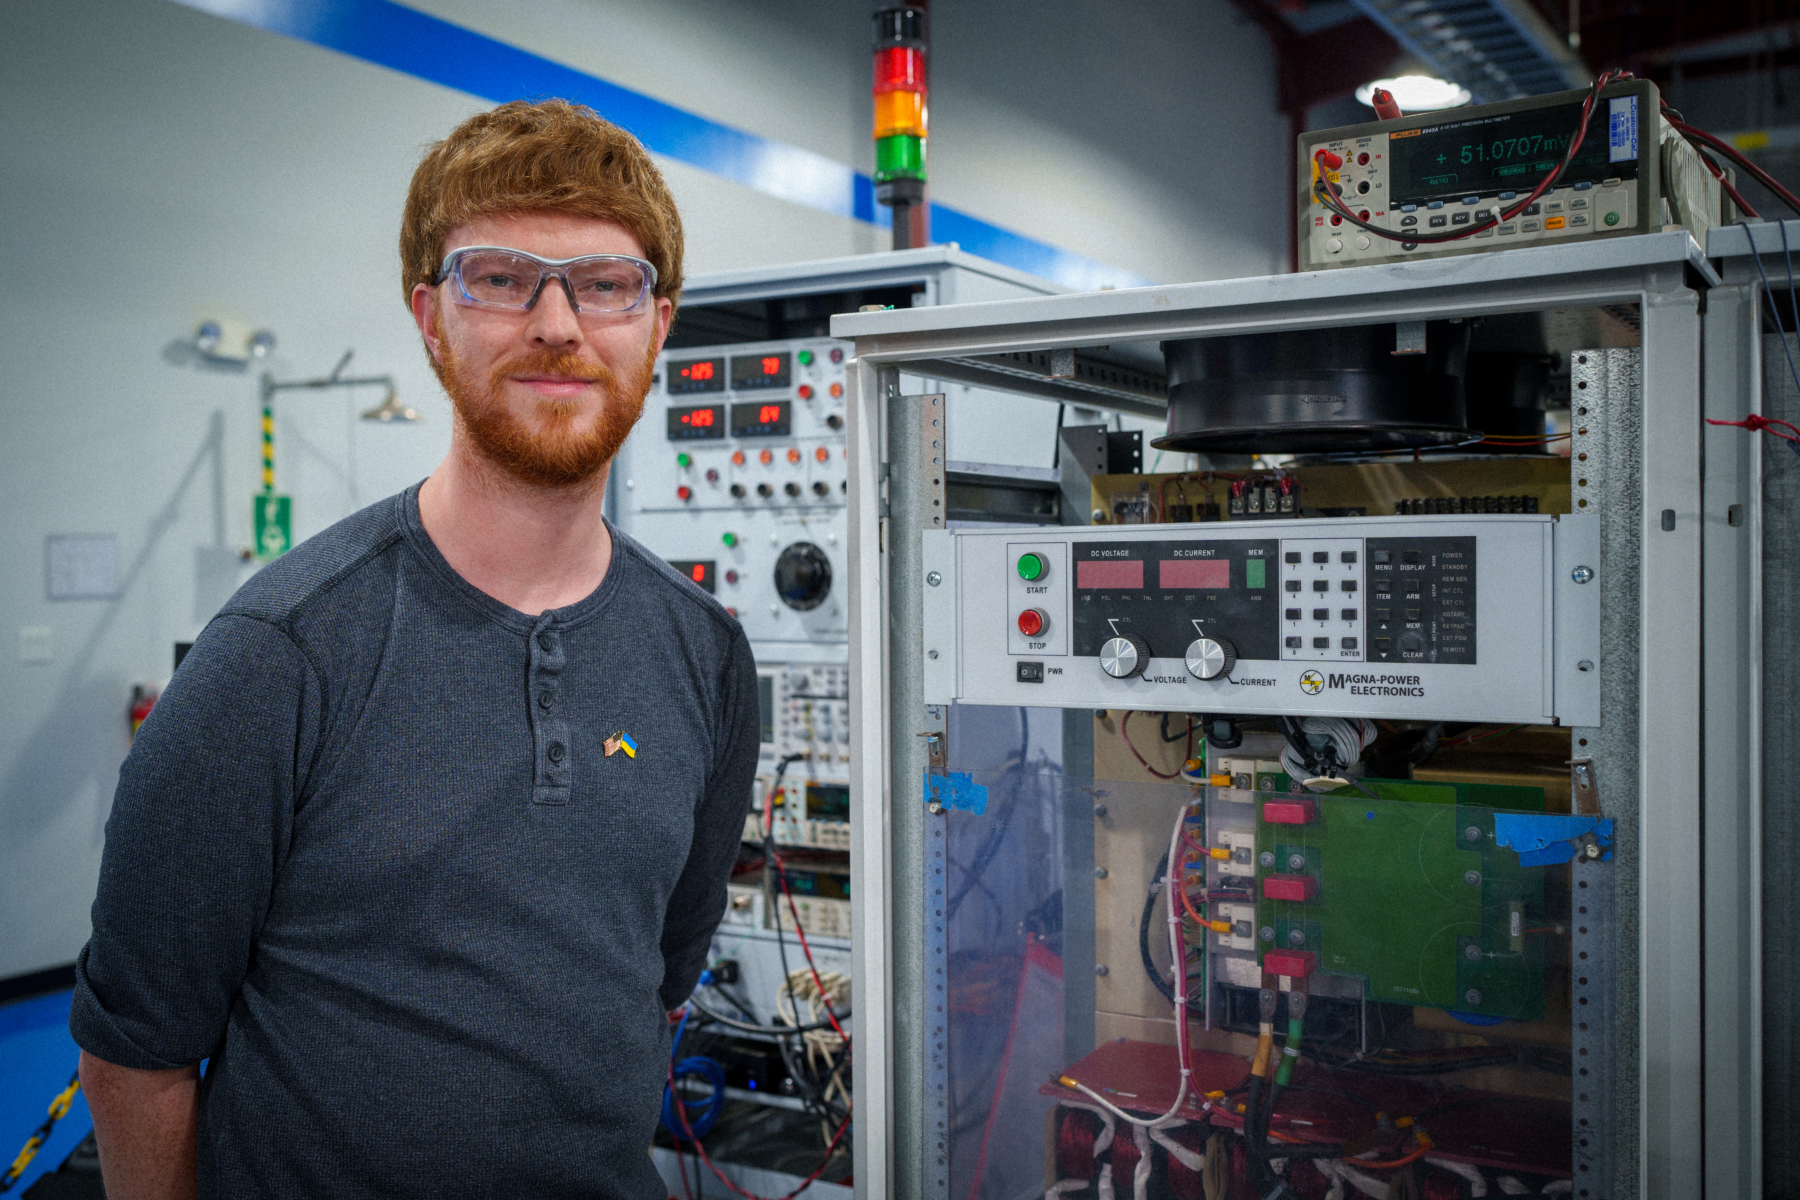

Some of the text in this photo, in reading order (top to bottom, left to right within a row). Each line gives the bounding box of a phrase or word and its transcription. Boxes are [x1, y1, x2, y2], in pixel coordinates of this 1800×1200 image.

[1460, 133, 1570, 164] 51.0707mV
[1430, 177, 1448, 186] RATIO
[1328, 674, 1420, 689] MAGNA-POWER
[1350, 686, 1424, 697] ELECTRONICS
